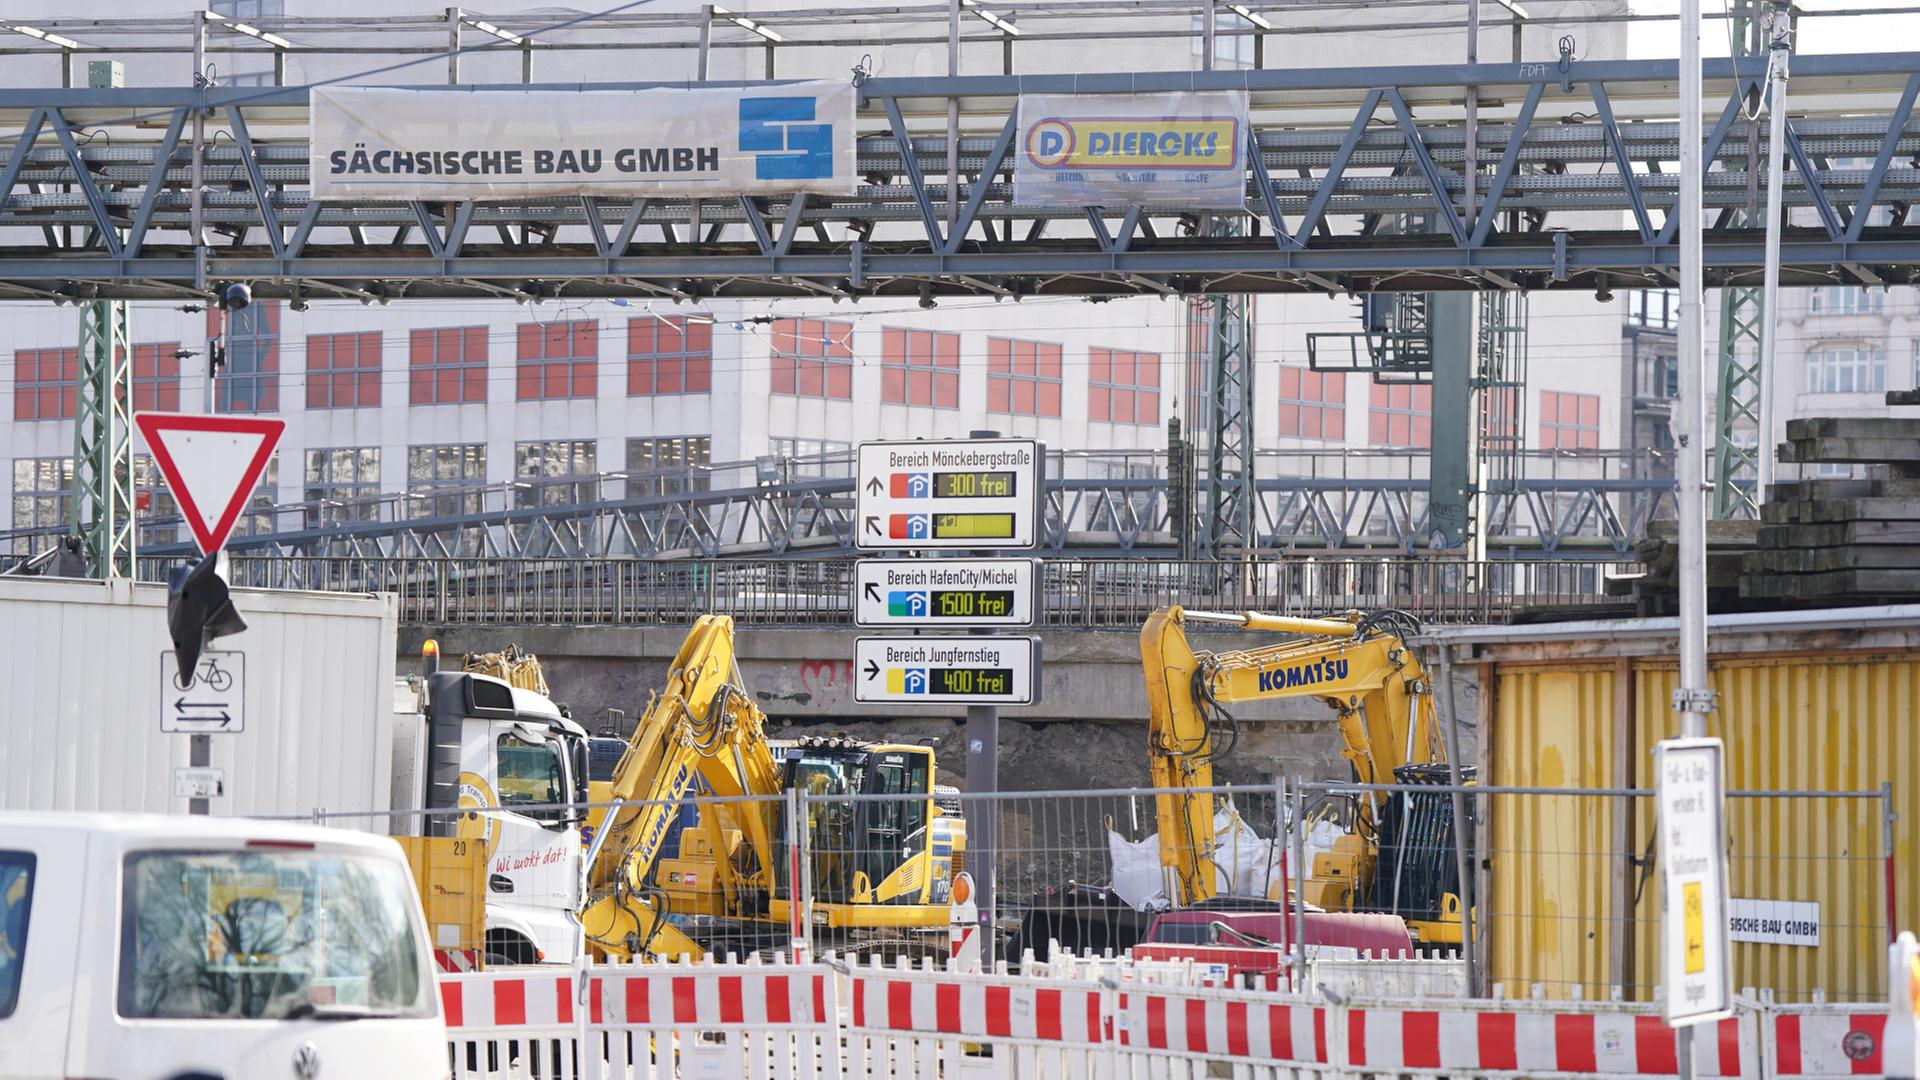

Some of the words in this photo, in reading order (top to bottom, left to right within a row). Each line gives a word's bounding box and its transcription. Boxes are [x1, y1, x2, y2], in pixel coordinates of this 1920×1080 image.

[1087, 130, 1218, 157] DIERCKS
[330, 143, 522, 175] SÄCHSISCHE
[534, 148, 601, 174] BAU
[614, 147, 719, 173] GMBH
[890, 451, 929, 467] Bereich
[932, 449, 1030, 469] Mönckebergstraße
[948, 474, 975, 496] 300
[980, 473, 1007, 496] frei
[888, 569, 927, 585] Bereich
[930, 569, 1017, 588] HafenCity/Michel
[939, 593, 973, 615] 1500
[978, 593, 1005, 615] frei
[887, 646, 926, 662] Bereich
[928, 647, 1000, 666] Jungfernstieg
[944, 670, 972, 692] 400
[976, 671, 1003, 692] frei
[1258, 656, 1348, 692] KOMATSU
[453, 841, 466, 856] 20
[543, 847, 567, 864] dat!
[937, 880, 950, 893] 170
[1762, 919, 1781, 934] BAU
[1785, 920, 1817, 937] GMBH
